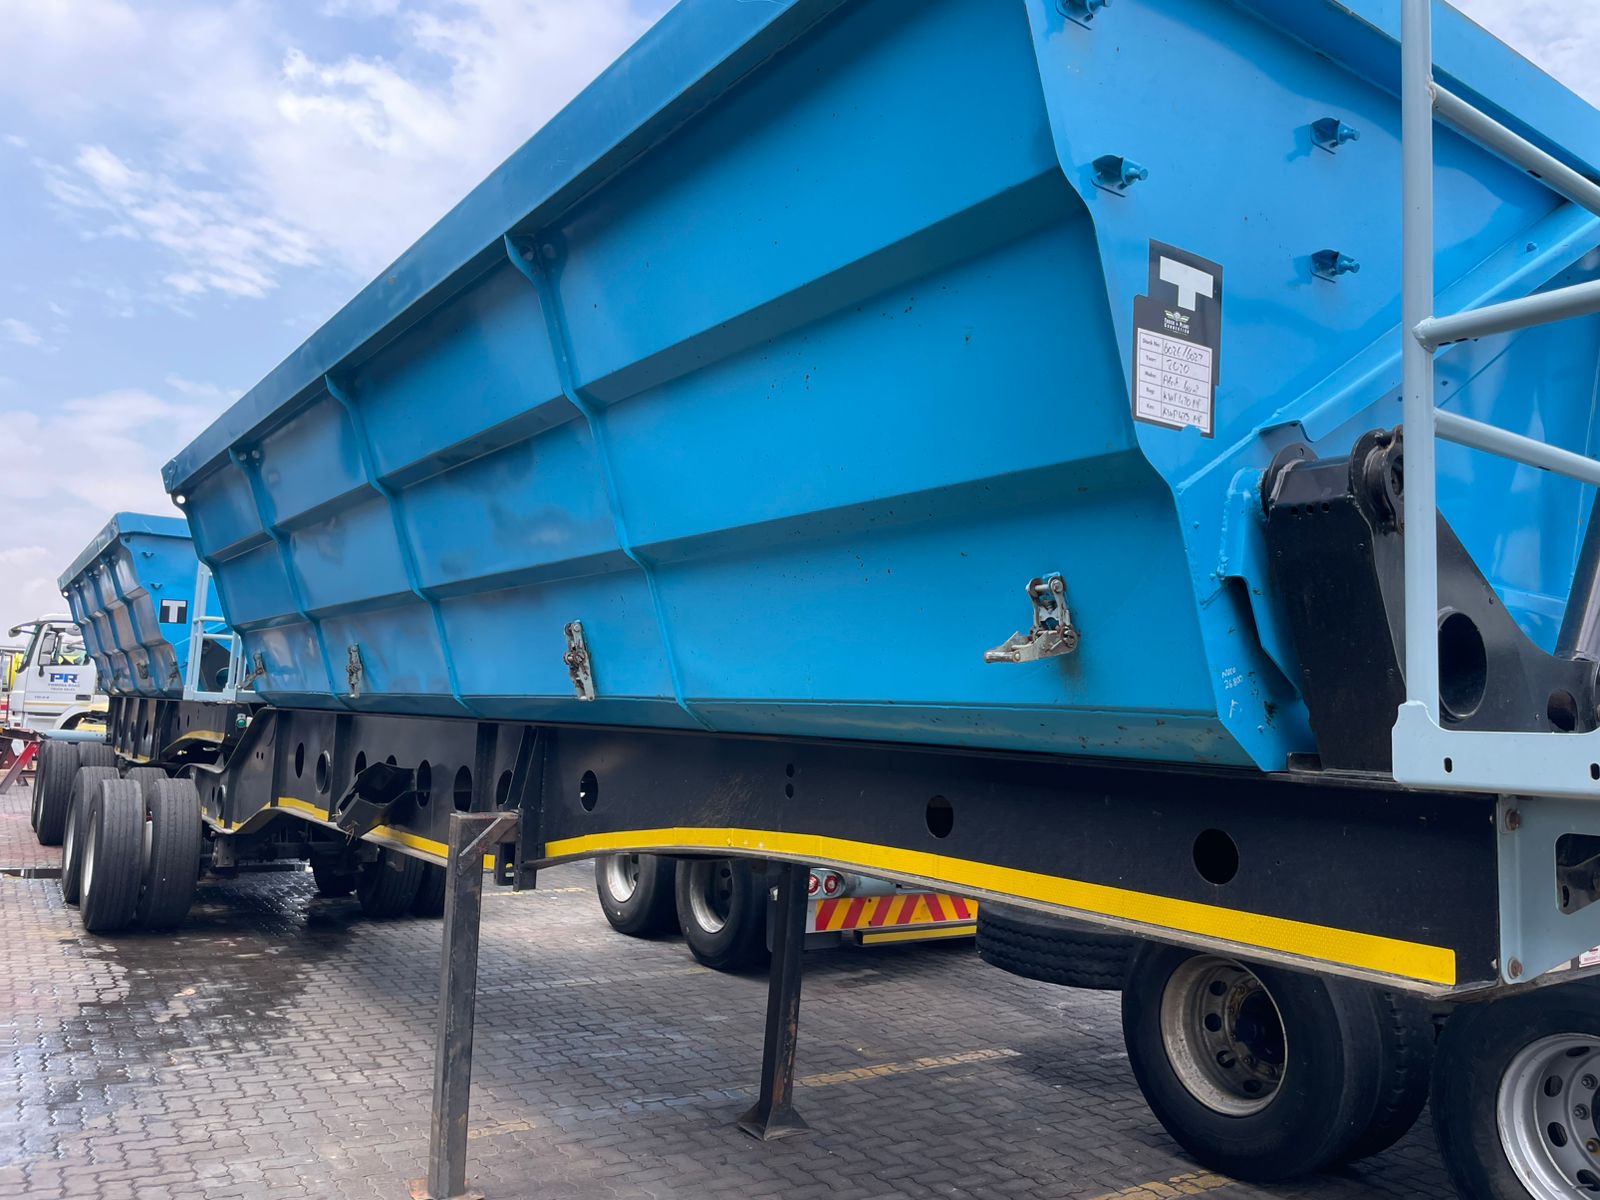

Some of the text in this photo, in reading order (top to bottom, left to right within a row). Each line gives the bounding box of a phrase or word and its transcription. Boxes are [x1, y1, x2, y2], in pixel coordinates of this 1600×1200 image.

[1159, 255, 1214, 312] T
[162, 599, 187, 623] T
[49, 673, 78, 683] PR
